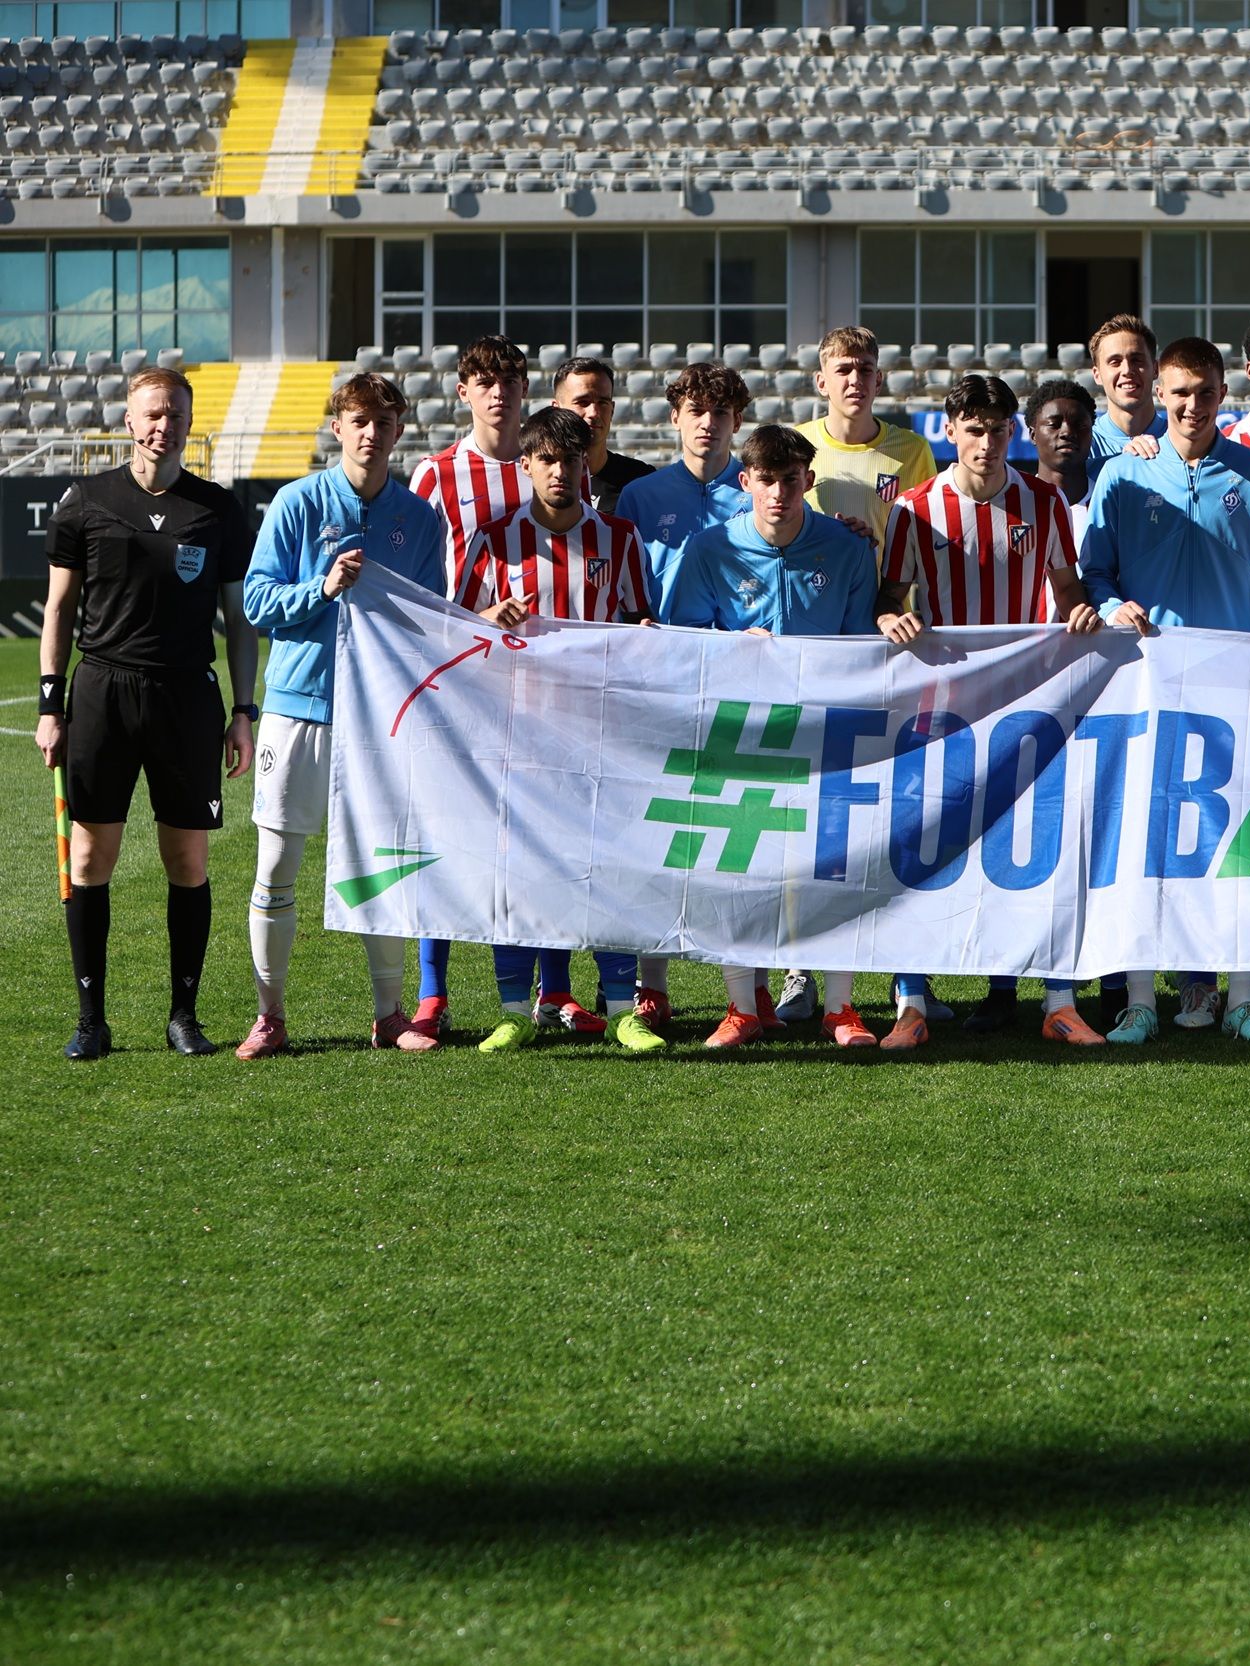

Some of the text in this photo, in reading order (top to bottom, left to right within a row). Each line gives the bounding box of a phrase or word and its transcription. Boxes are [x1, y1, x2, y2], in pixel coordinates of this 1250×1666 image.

[1150, 509, 1159, 524] 4
[662, 528, 670, 542] 3
[322, 540, 339, 556] 10
[177, 565, 199, 573] OFFICIAL
[181, 559, 199, 567] MATCH
[742, 592, 757, 609] 11
[254, 893, 286, 902] FCDK
